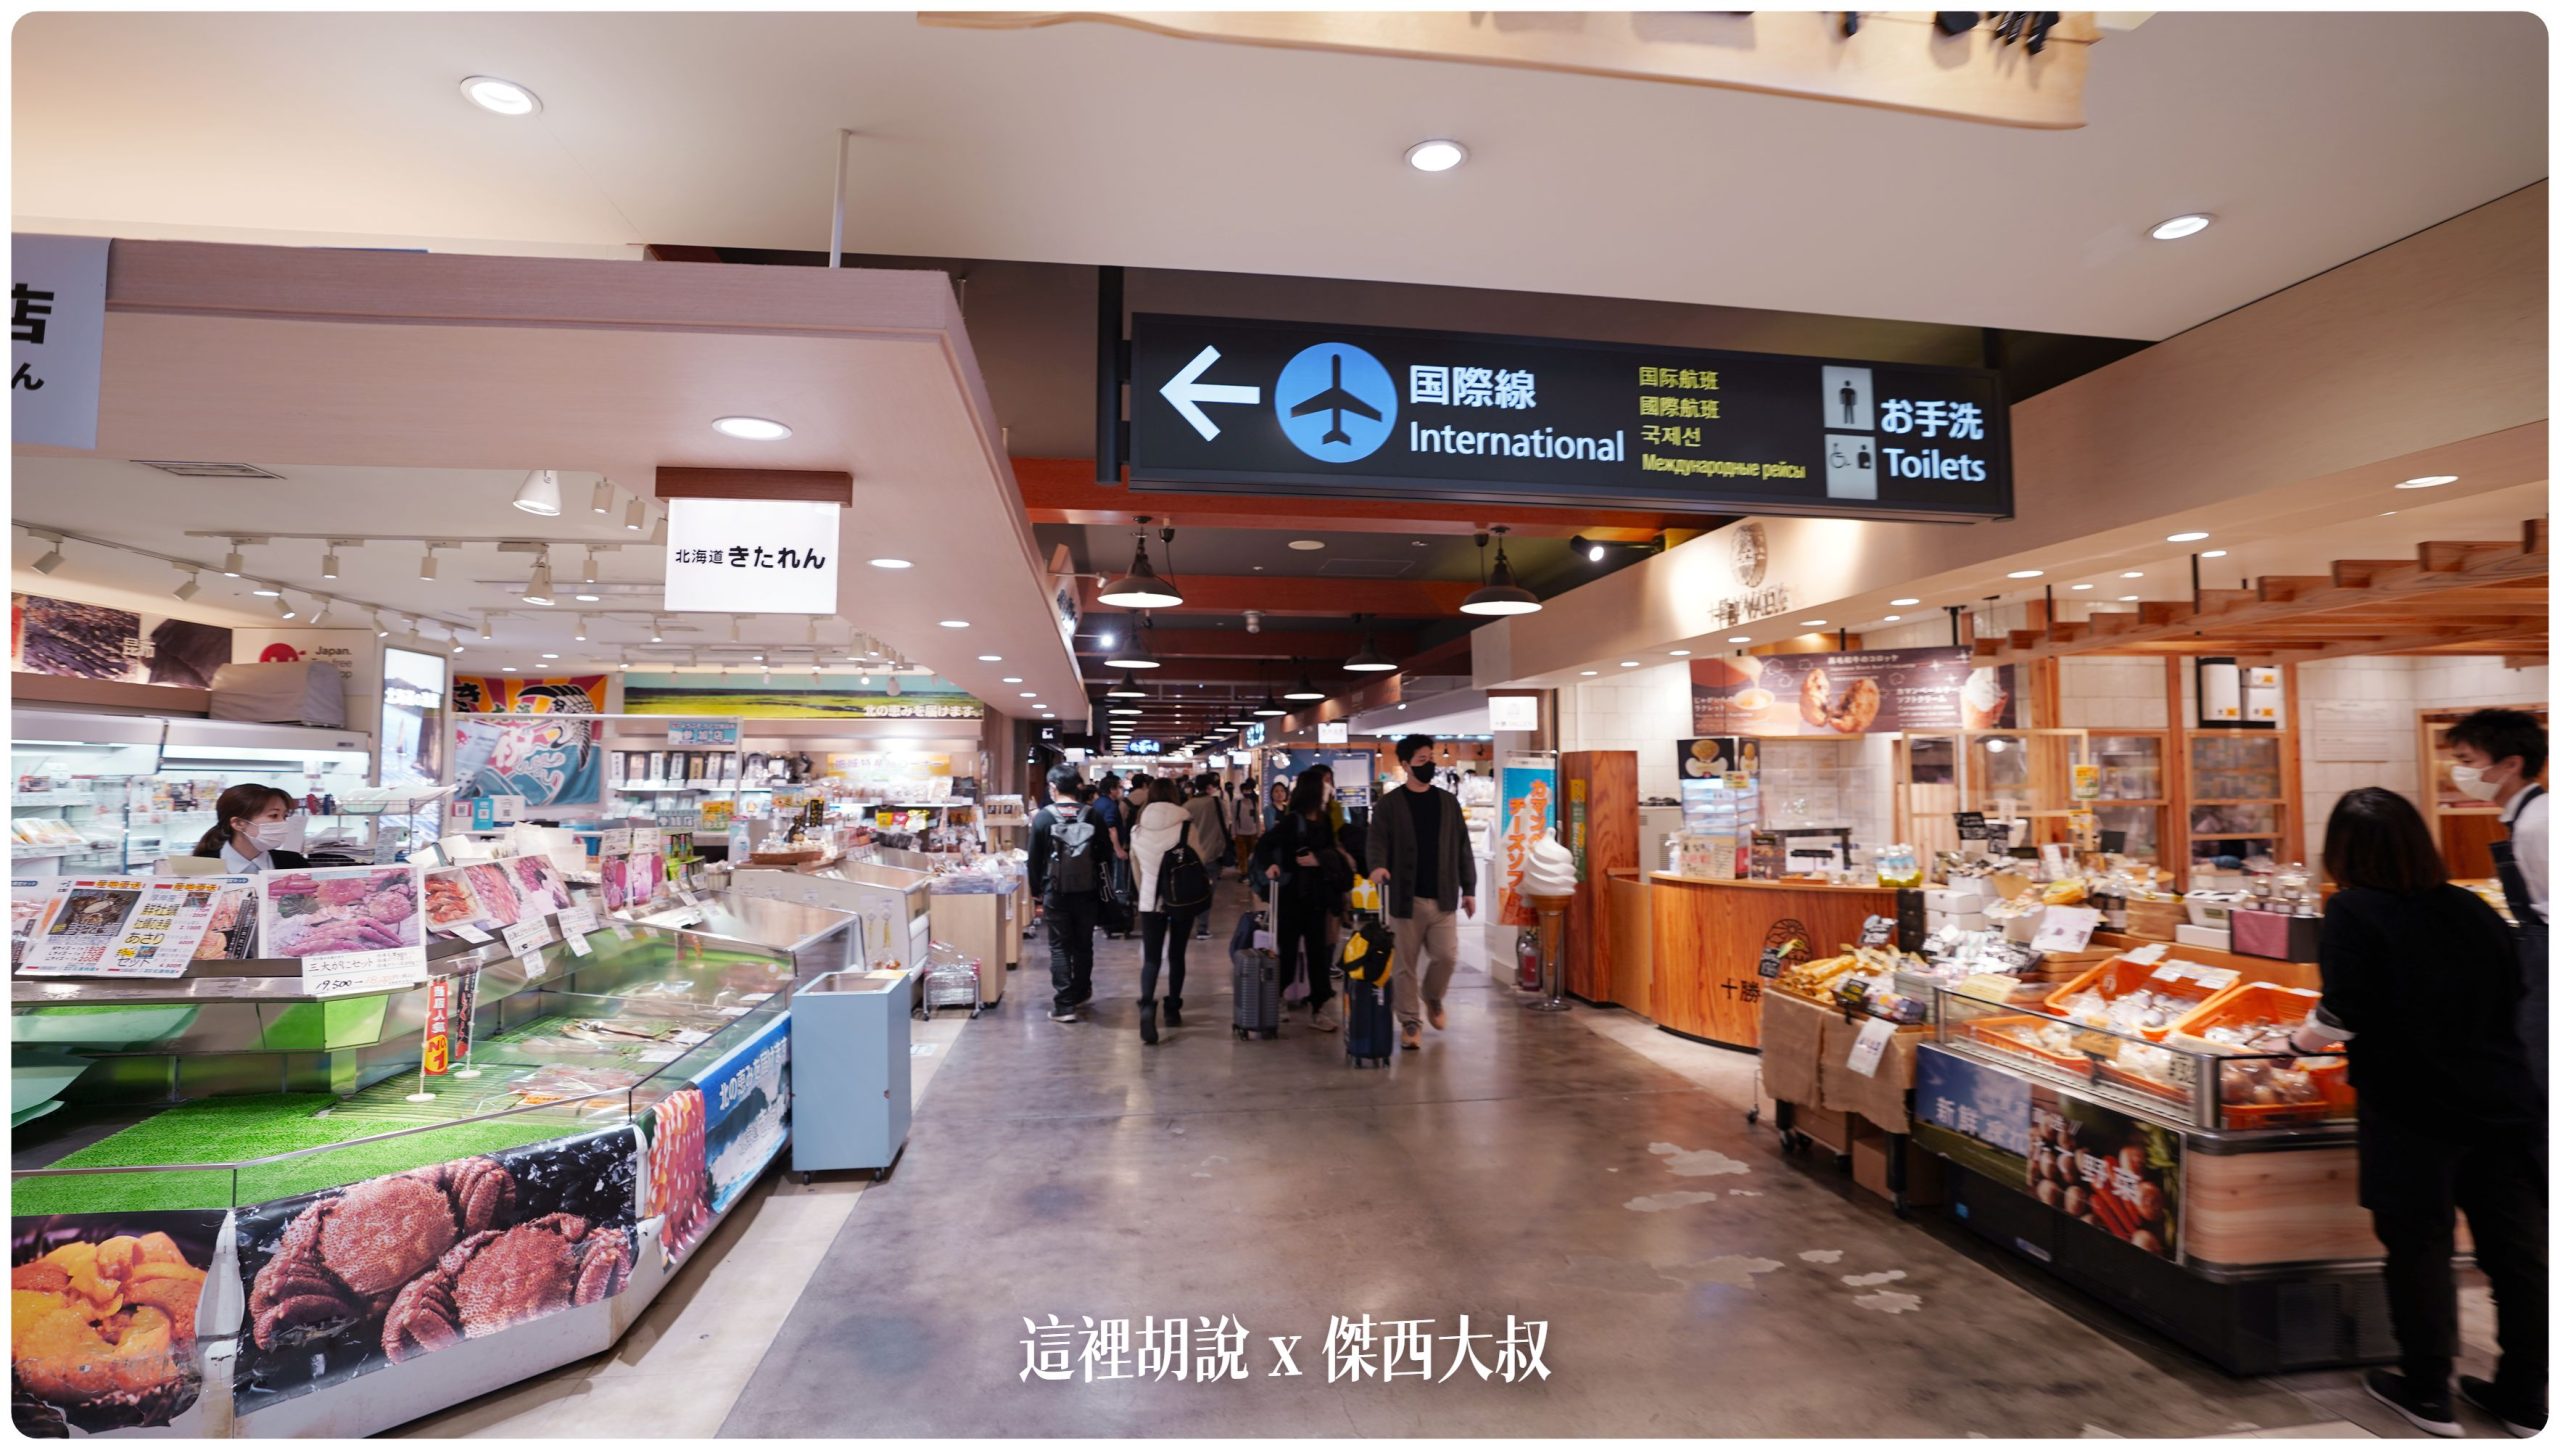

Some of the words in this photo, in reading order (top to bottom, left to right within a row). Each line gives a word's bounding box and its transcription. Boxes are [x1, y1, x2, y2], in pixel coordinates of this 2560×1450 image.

[1409, 364, 1537, 410] 国際線
[1638, 366, 1720, 391] 国际航班
[1639, 396, 1721, 420] 國際航班
[1880, 397, 1985, 441] お手洗
[1409, 421, 1625, 463] International
[1640, 425, 1702, 448] 국제선
[1641, 453, 1761, 478] Международные
[1762, 461, 1807, 481] рейсы
[1881, 447, 1987, 483] Toilets
[675, 548, 724, 565] 北海道
[727, 545, 826, 570] きたれん
[1720, 977, 1761, 1004] 十勝
